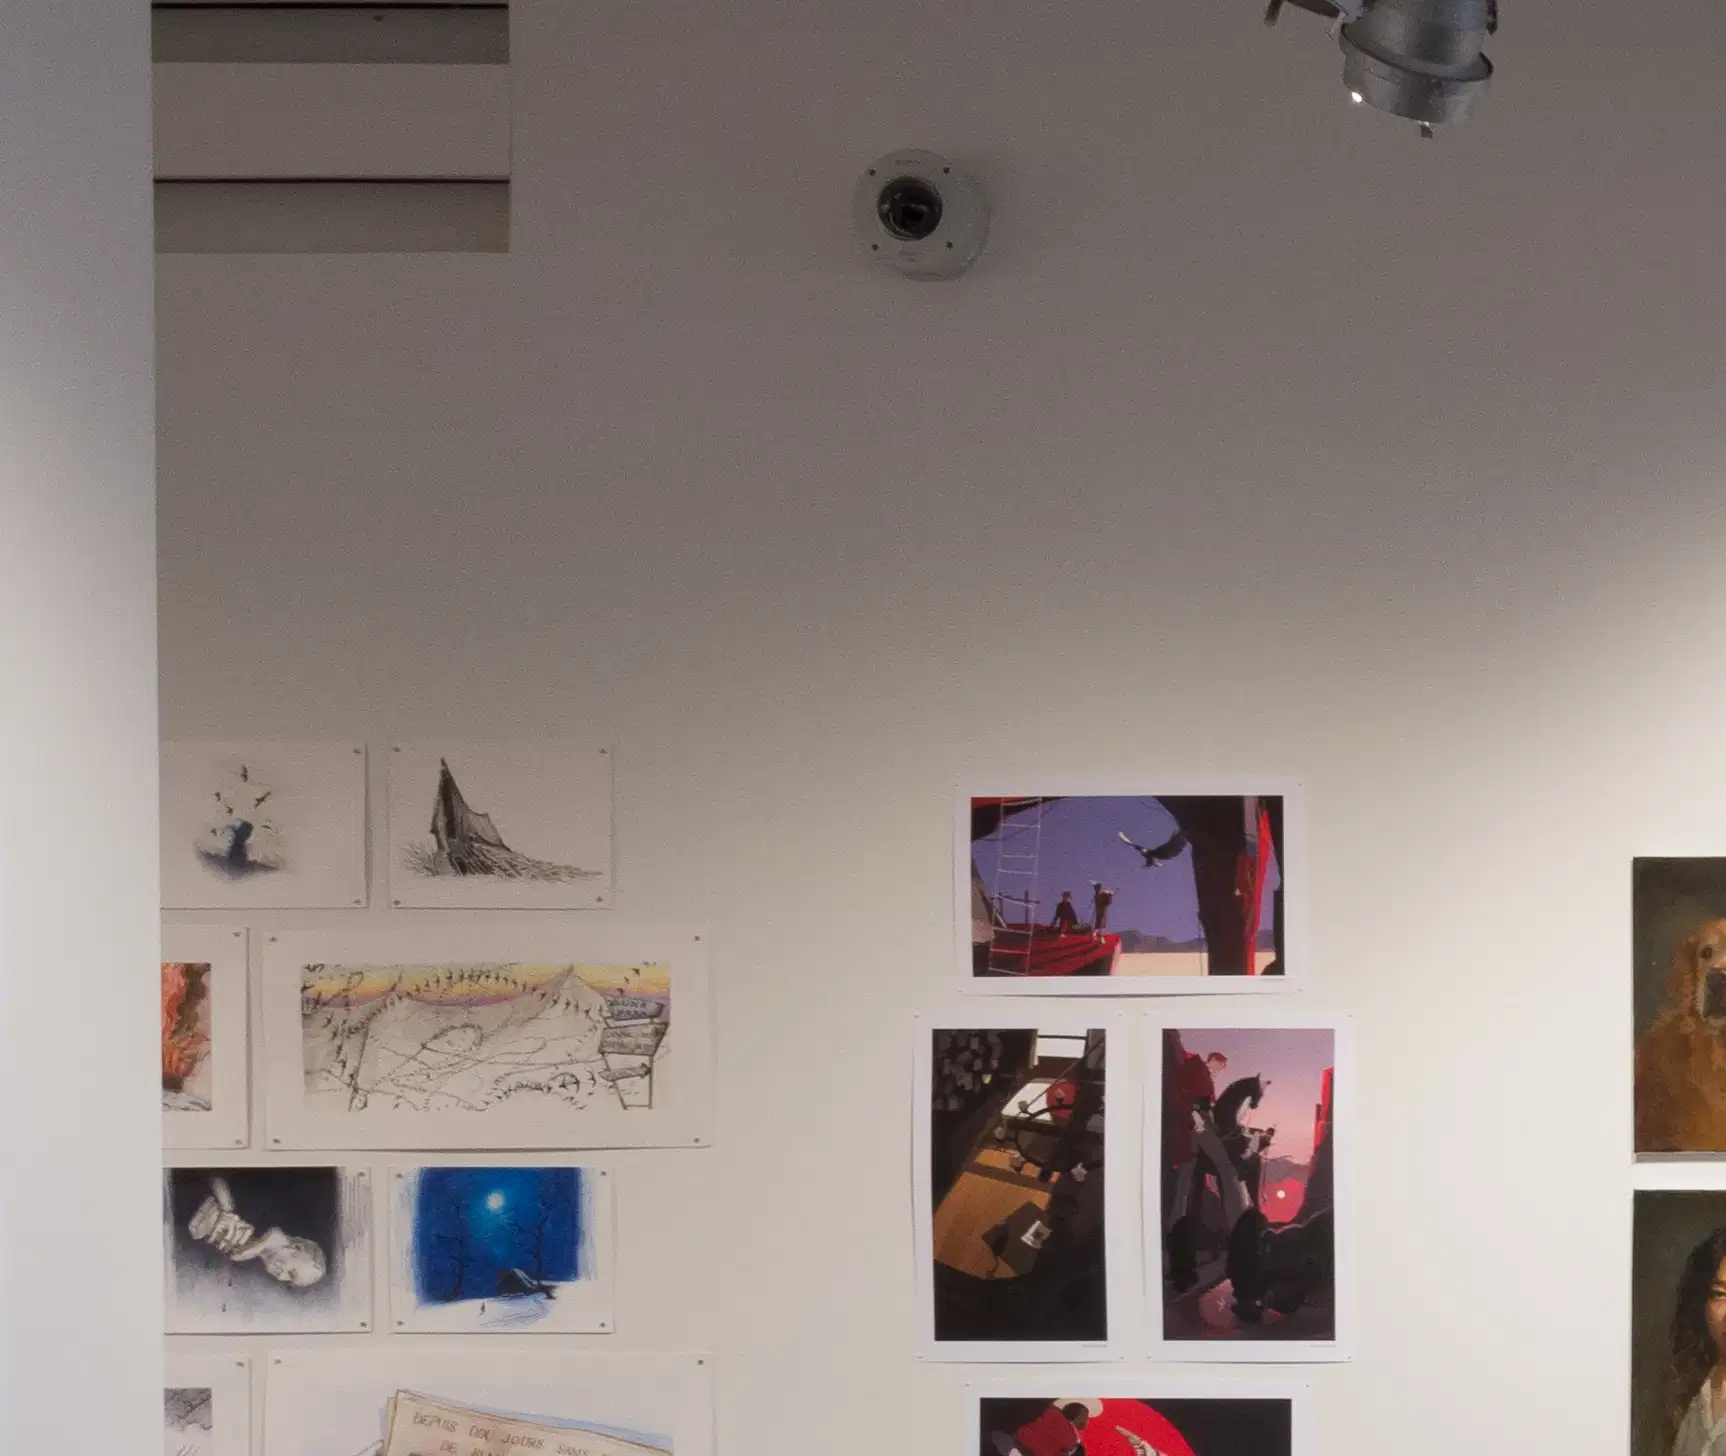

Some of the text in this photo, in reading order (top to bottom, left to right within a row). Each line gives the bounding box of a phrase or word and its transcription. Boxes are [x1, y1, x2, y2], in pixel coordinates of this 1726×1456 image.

[413, 1411, 459, 1432] DEPUIS
[500, 1433, 546, 1448] JOURS
[440, 1440, 458, 1453] DE
